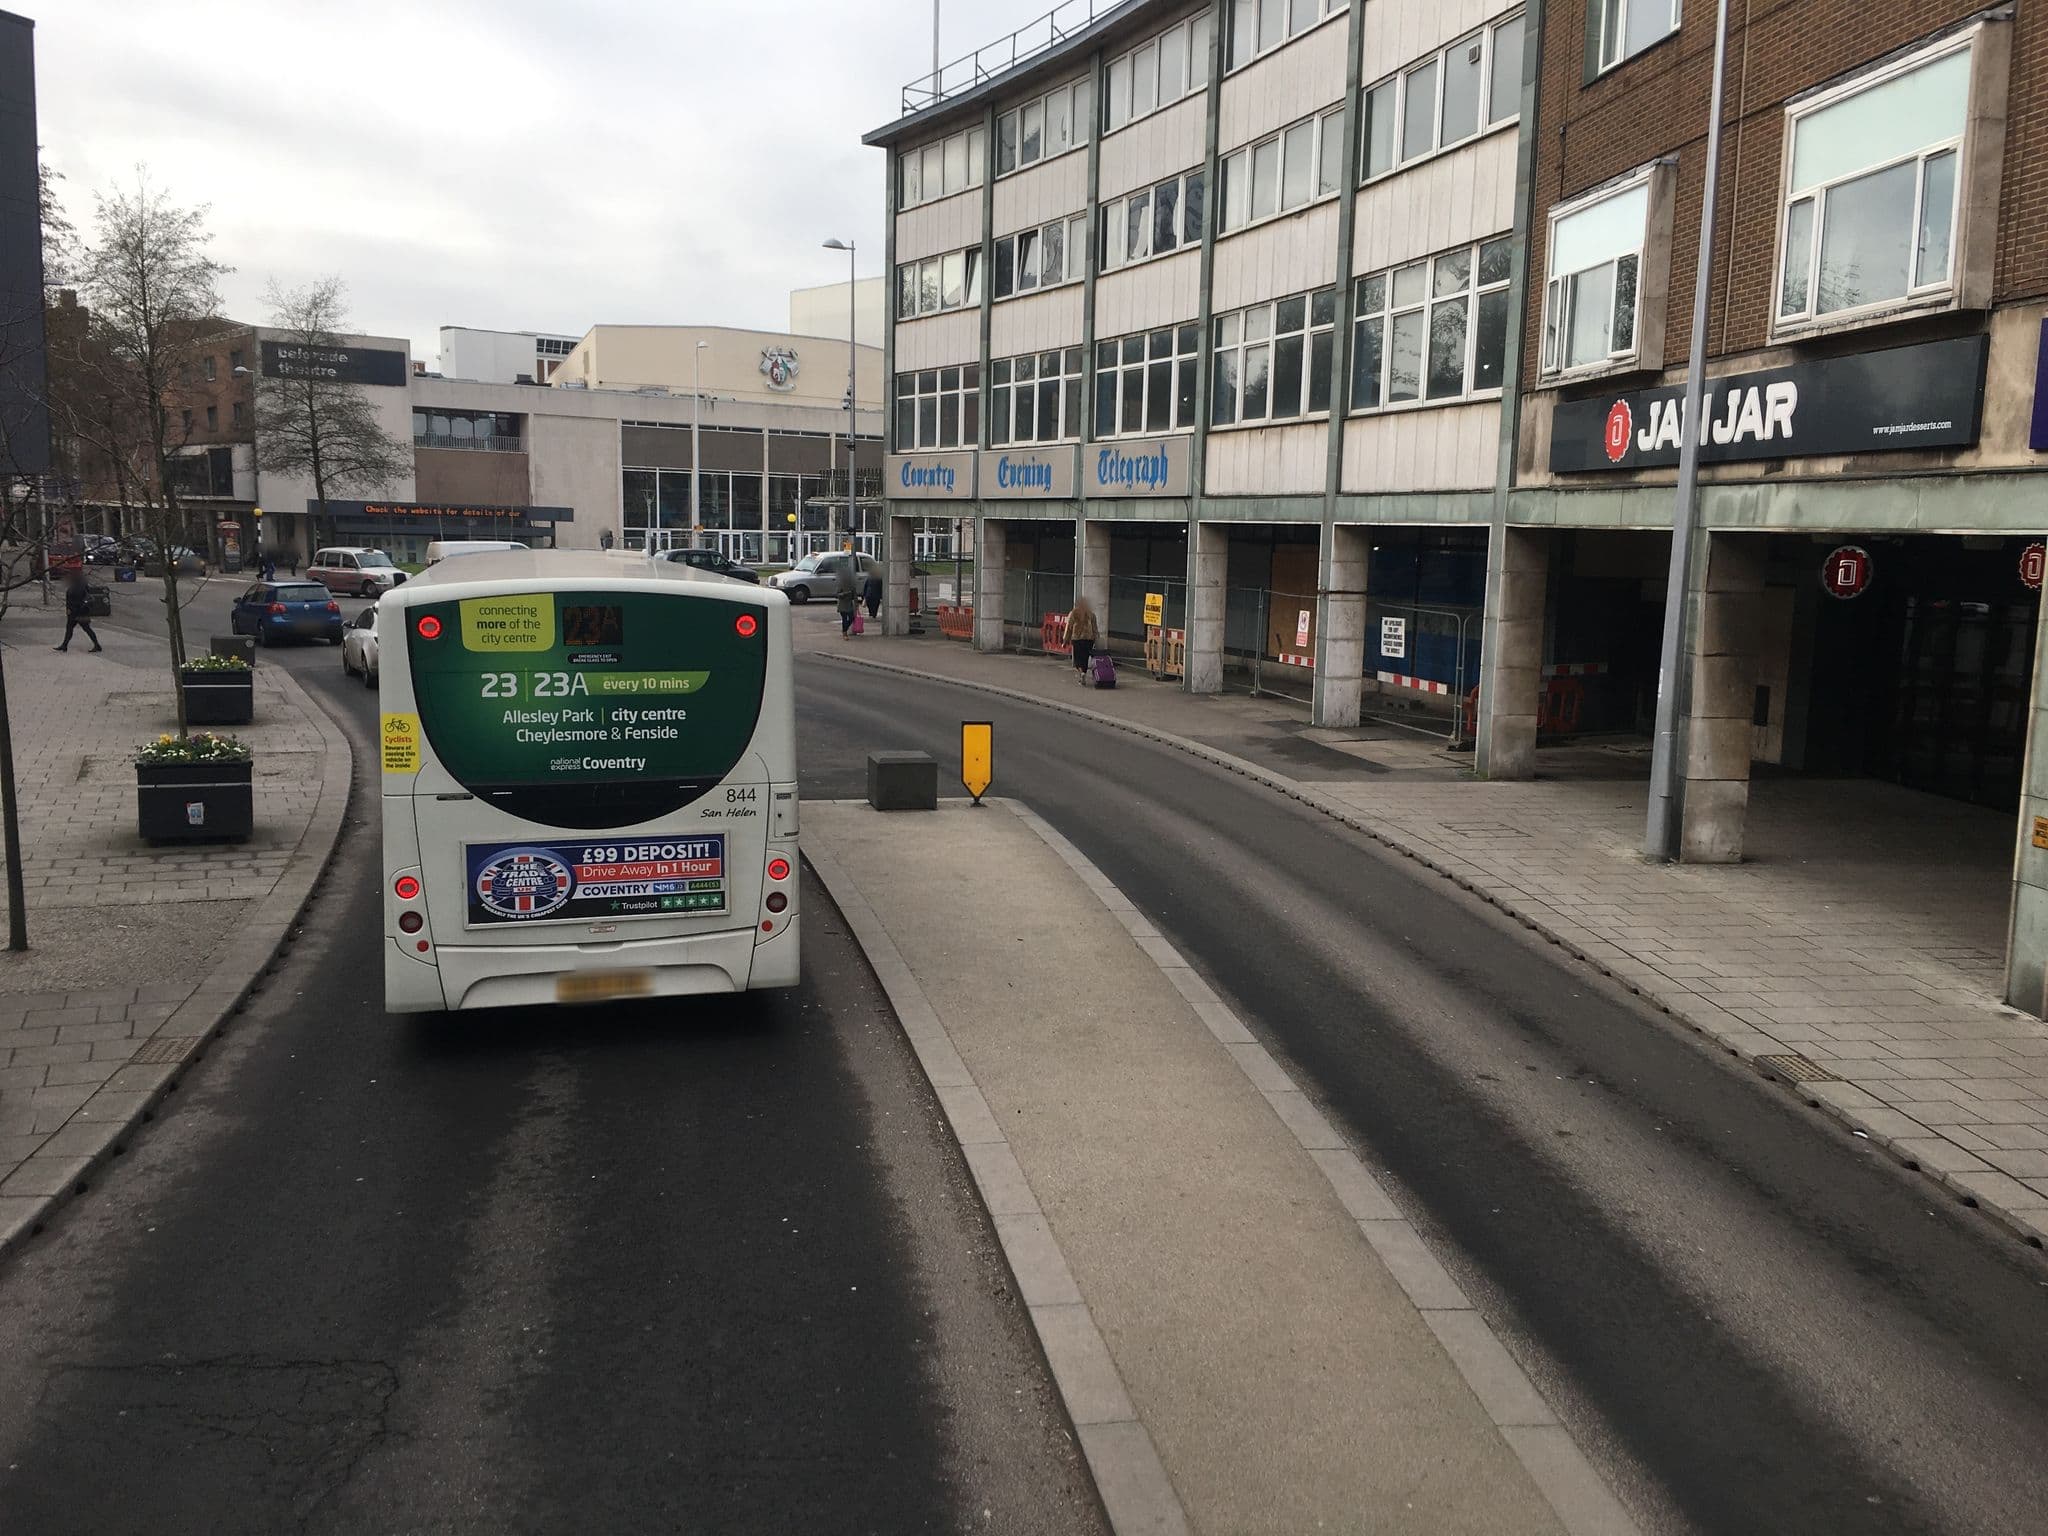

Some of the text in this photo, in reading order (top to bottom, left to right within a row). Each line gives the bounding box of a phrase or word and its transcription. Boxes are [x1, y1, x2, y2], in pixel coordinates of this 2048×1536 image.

[1713, 381, 1798, 444] JAR
[1872, 421, 1952, 436] www.jamjardesserts.com
[901, 443, 1168, 493] Coventry Evening Telegraph
[393, 506, 407, 514] the
[411, 507, 442, 515] website
[446, 507, 458, 515] for
[462, 508, 493, 516] details
[495, 509, 505, 517] of
[478, 605, 538, 617] connecting
[476, 618, 541, 629] more of the
[481, 632, 537, 645] city centre
[481, 672, 589, 698] 23 23A
[603, 676, 690, 691] every 10 mins
[503, 708, 594, 725] Allesley Park
[611, 708, 686, 724] city centre
[385, 736, 412, 744] Cyclists
[516, 727, 678, 744] Cheylesmore & Fenside
[550, 763, 581, 771] express
[582, 756, 646, 771] Coventry
[726, 787, 757, 802] 844
[700, 806, 757, 818] San Helen
[582, 842, 710, 864] £99 DEPOSIT!
[501, 869, 548, 878] TRADE
[583, 862, 712, 877] Drive Away In 1 Hour
[506, 876, 544, 887] CENTRE
[582, 884, 649, 896] COVENTRY
[621, 900, 658, 910] Trustpilot
